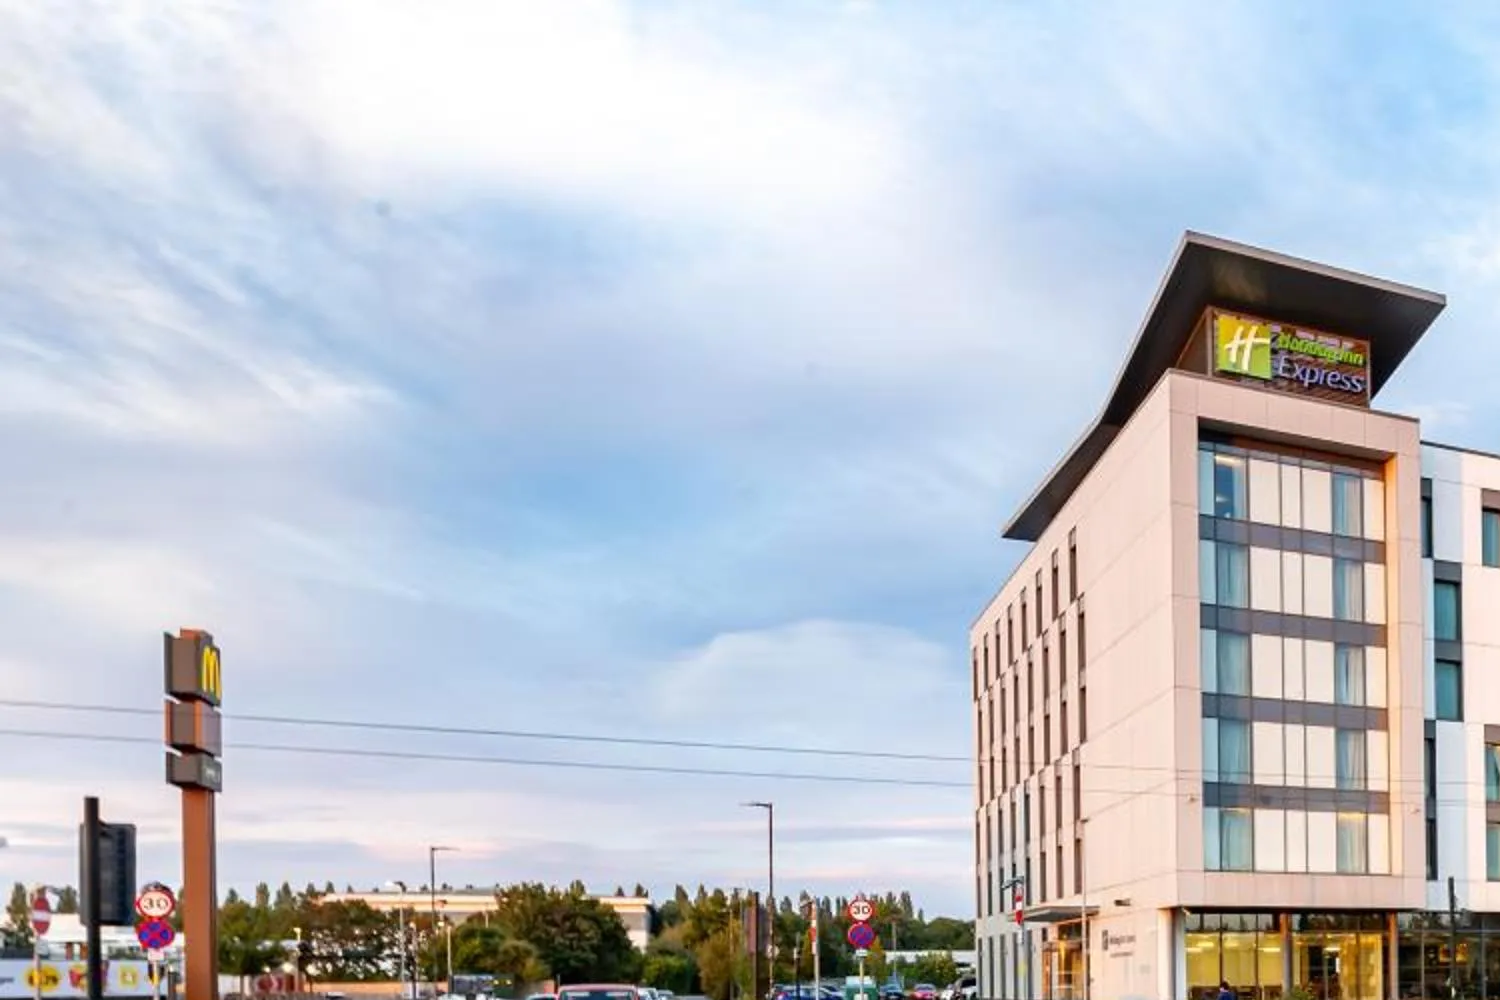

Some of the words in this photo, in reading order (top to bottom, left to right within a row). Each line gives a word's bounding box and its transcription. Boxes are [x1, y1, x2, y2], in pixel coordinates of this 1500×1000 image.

[1278, 353, 1364, 393] Express
[143, 897, 169, 911] 30
[853, 905, 871, 915] 30
